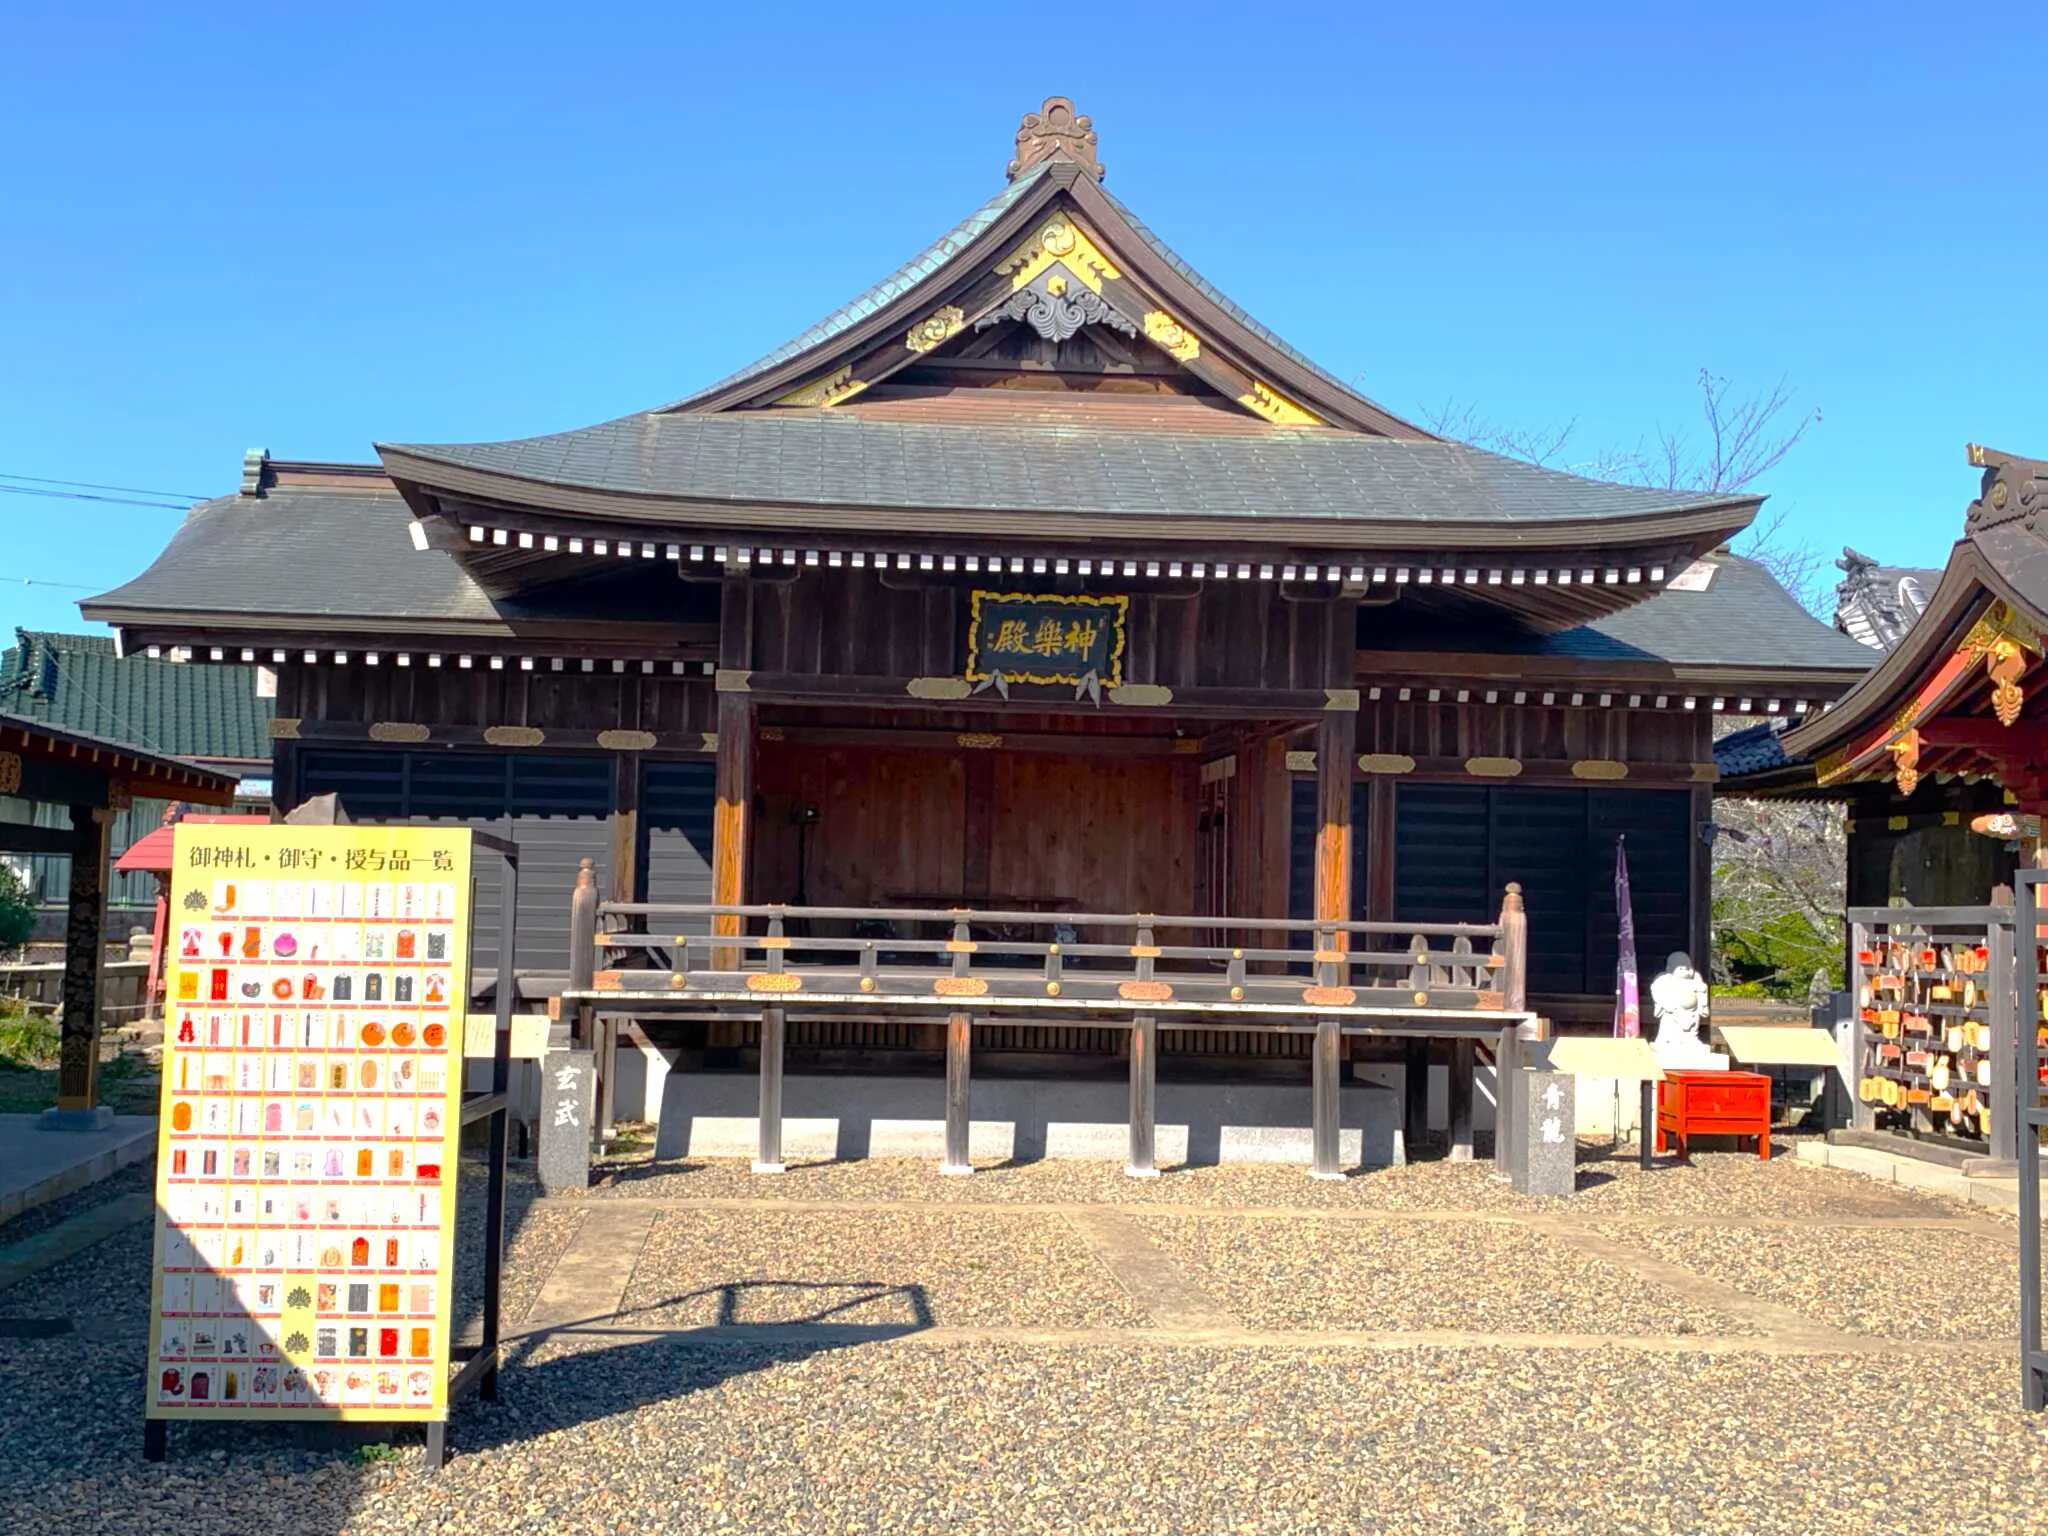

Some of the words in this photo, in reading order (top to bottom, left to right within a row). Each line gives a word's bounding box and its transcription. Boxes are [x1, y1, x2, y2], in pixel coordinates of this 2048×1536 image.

[189, 846, 454, 872] 御神札・御守・授与品一覧
[554, 1065, 582, 1127] 玄武
